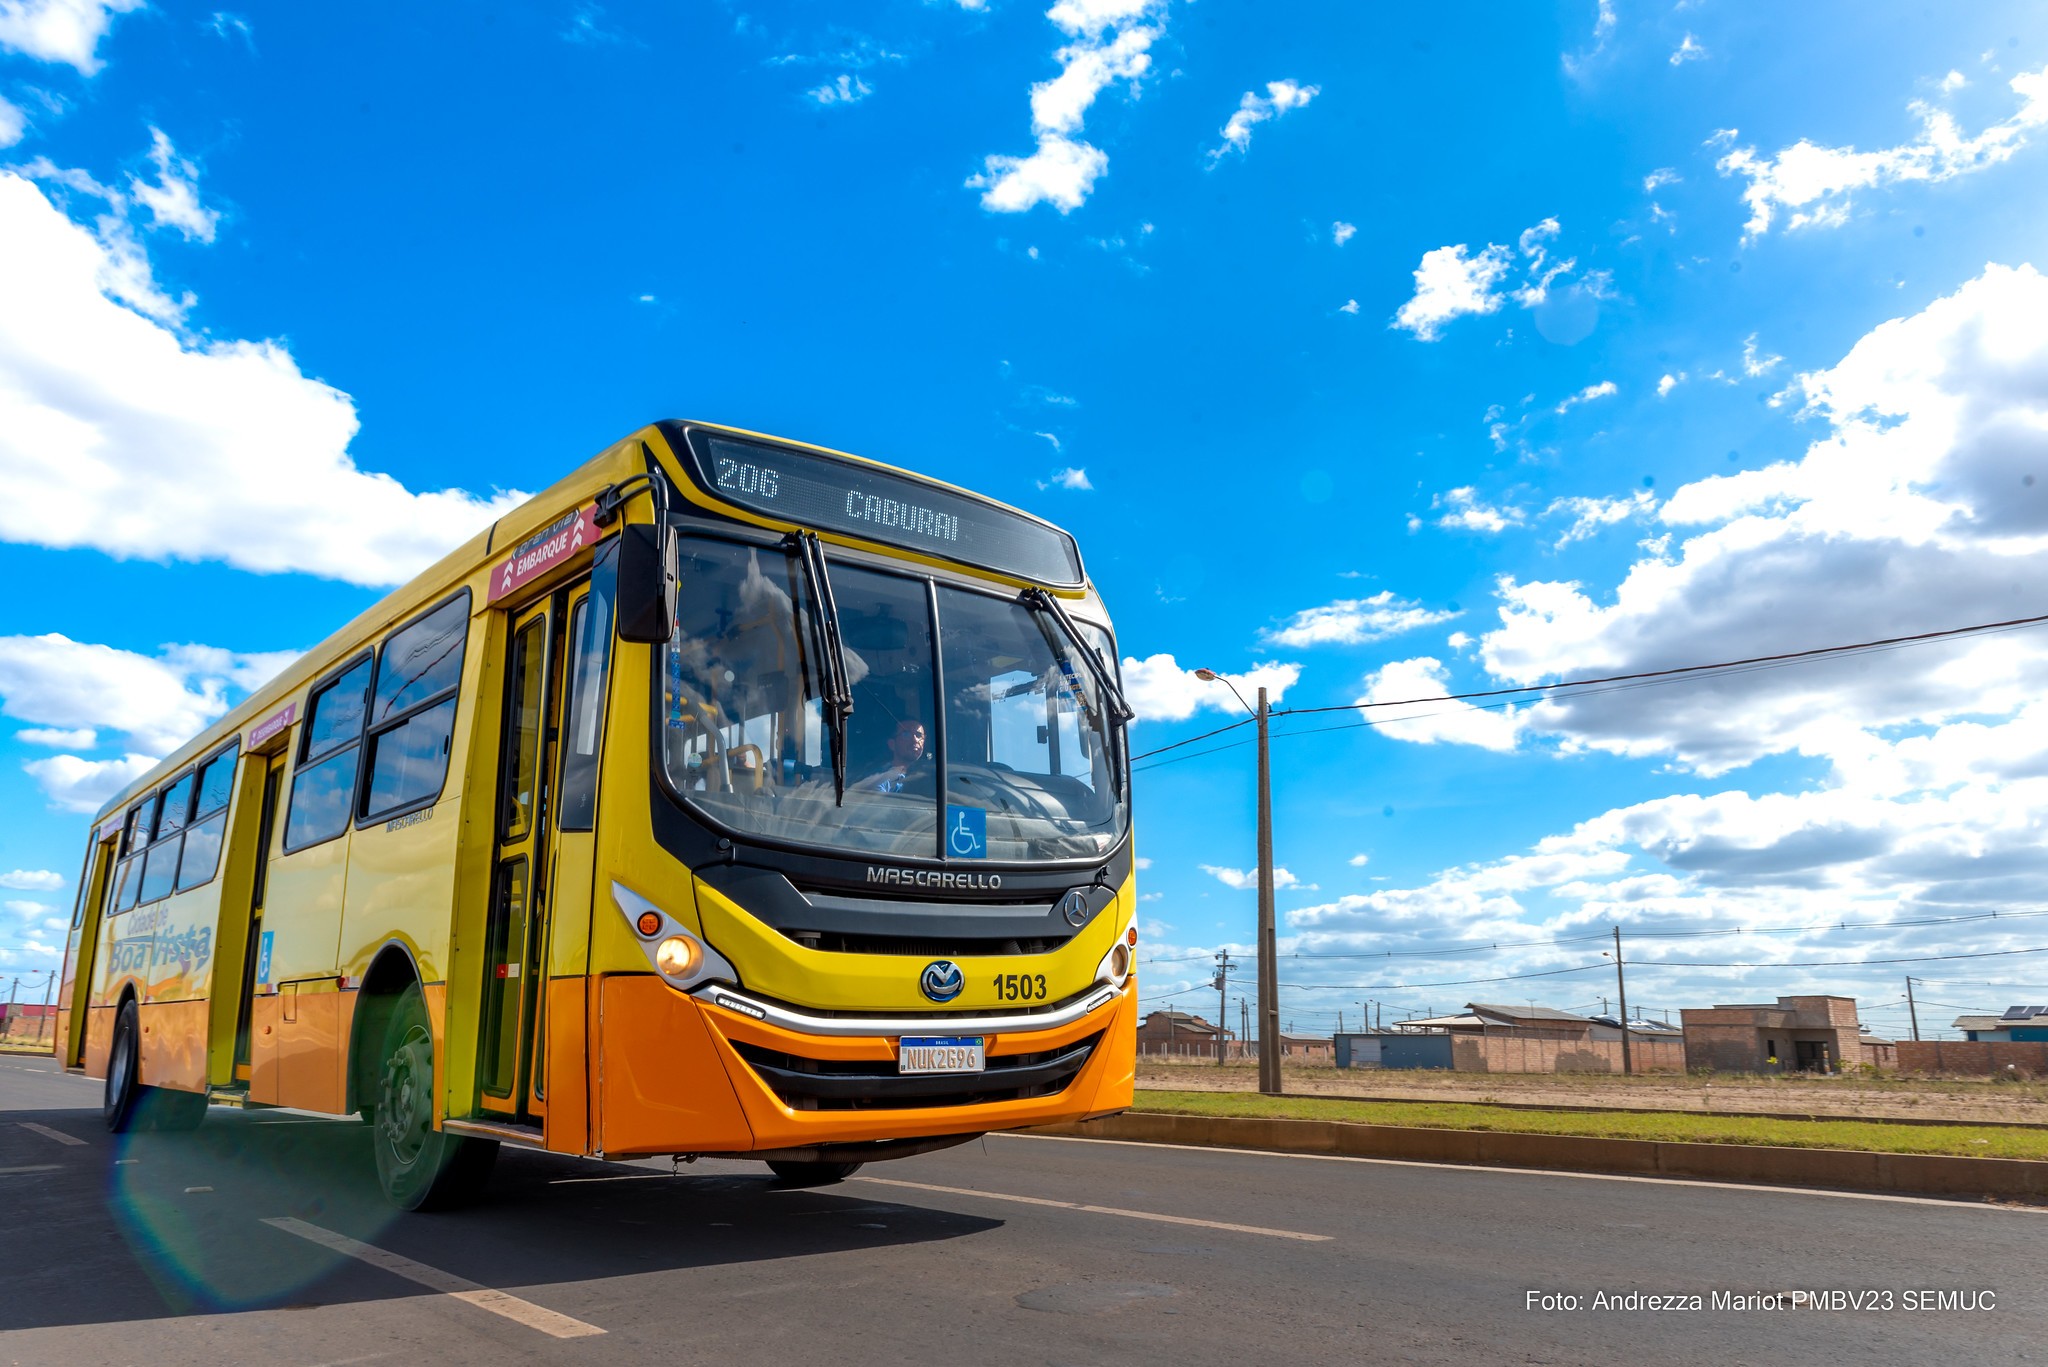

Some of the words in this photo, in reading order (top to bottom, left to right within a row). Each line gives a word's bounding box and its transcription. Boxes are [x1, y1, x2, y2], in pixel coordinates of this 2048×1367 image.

[717, 458, 778, 498] 206
[846, 490, 958, 541] CABURAI
[516, 531, 569, 577] EMBARQUE
[866, 866, 1002, 890] MASCARELLO
[109, 940, 146, 974] Boa
[151, 924, 212, 972] Vista
[993, 973, 1047, 1001] 1503
[907, 1047, 977, 1070] NUK2G96
